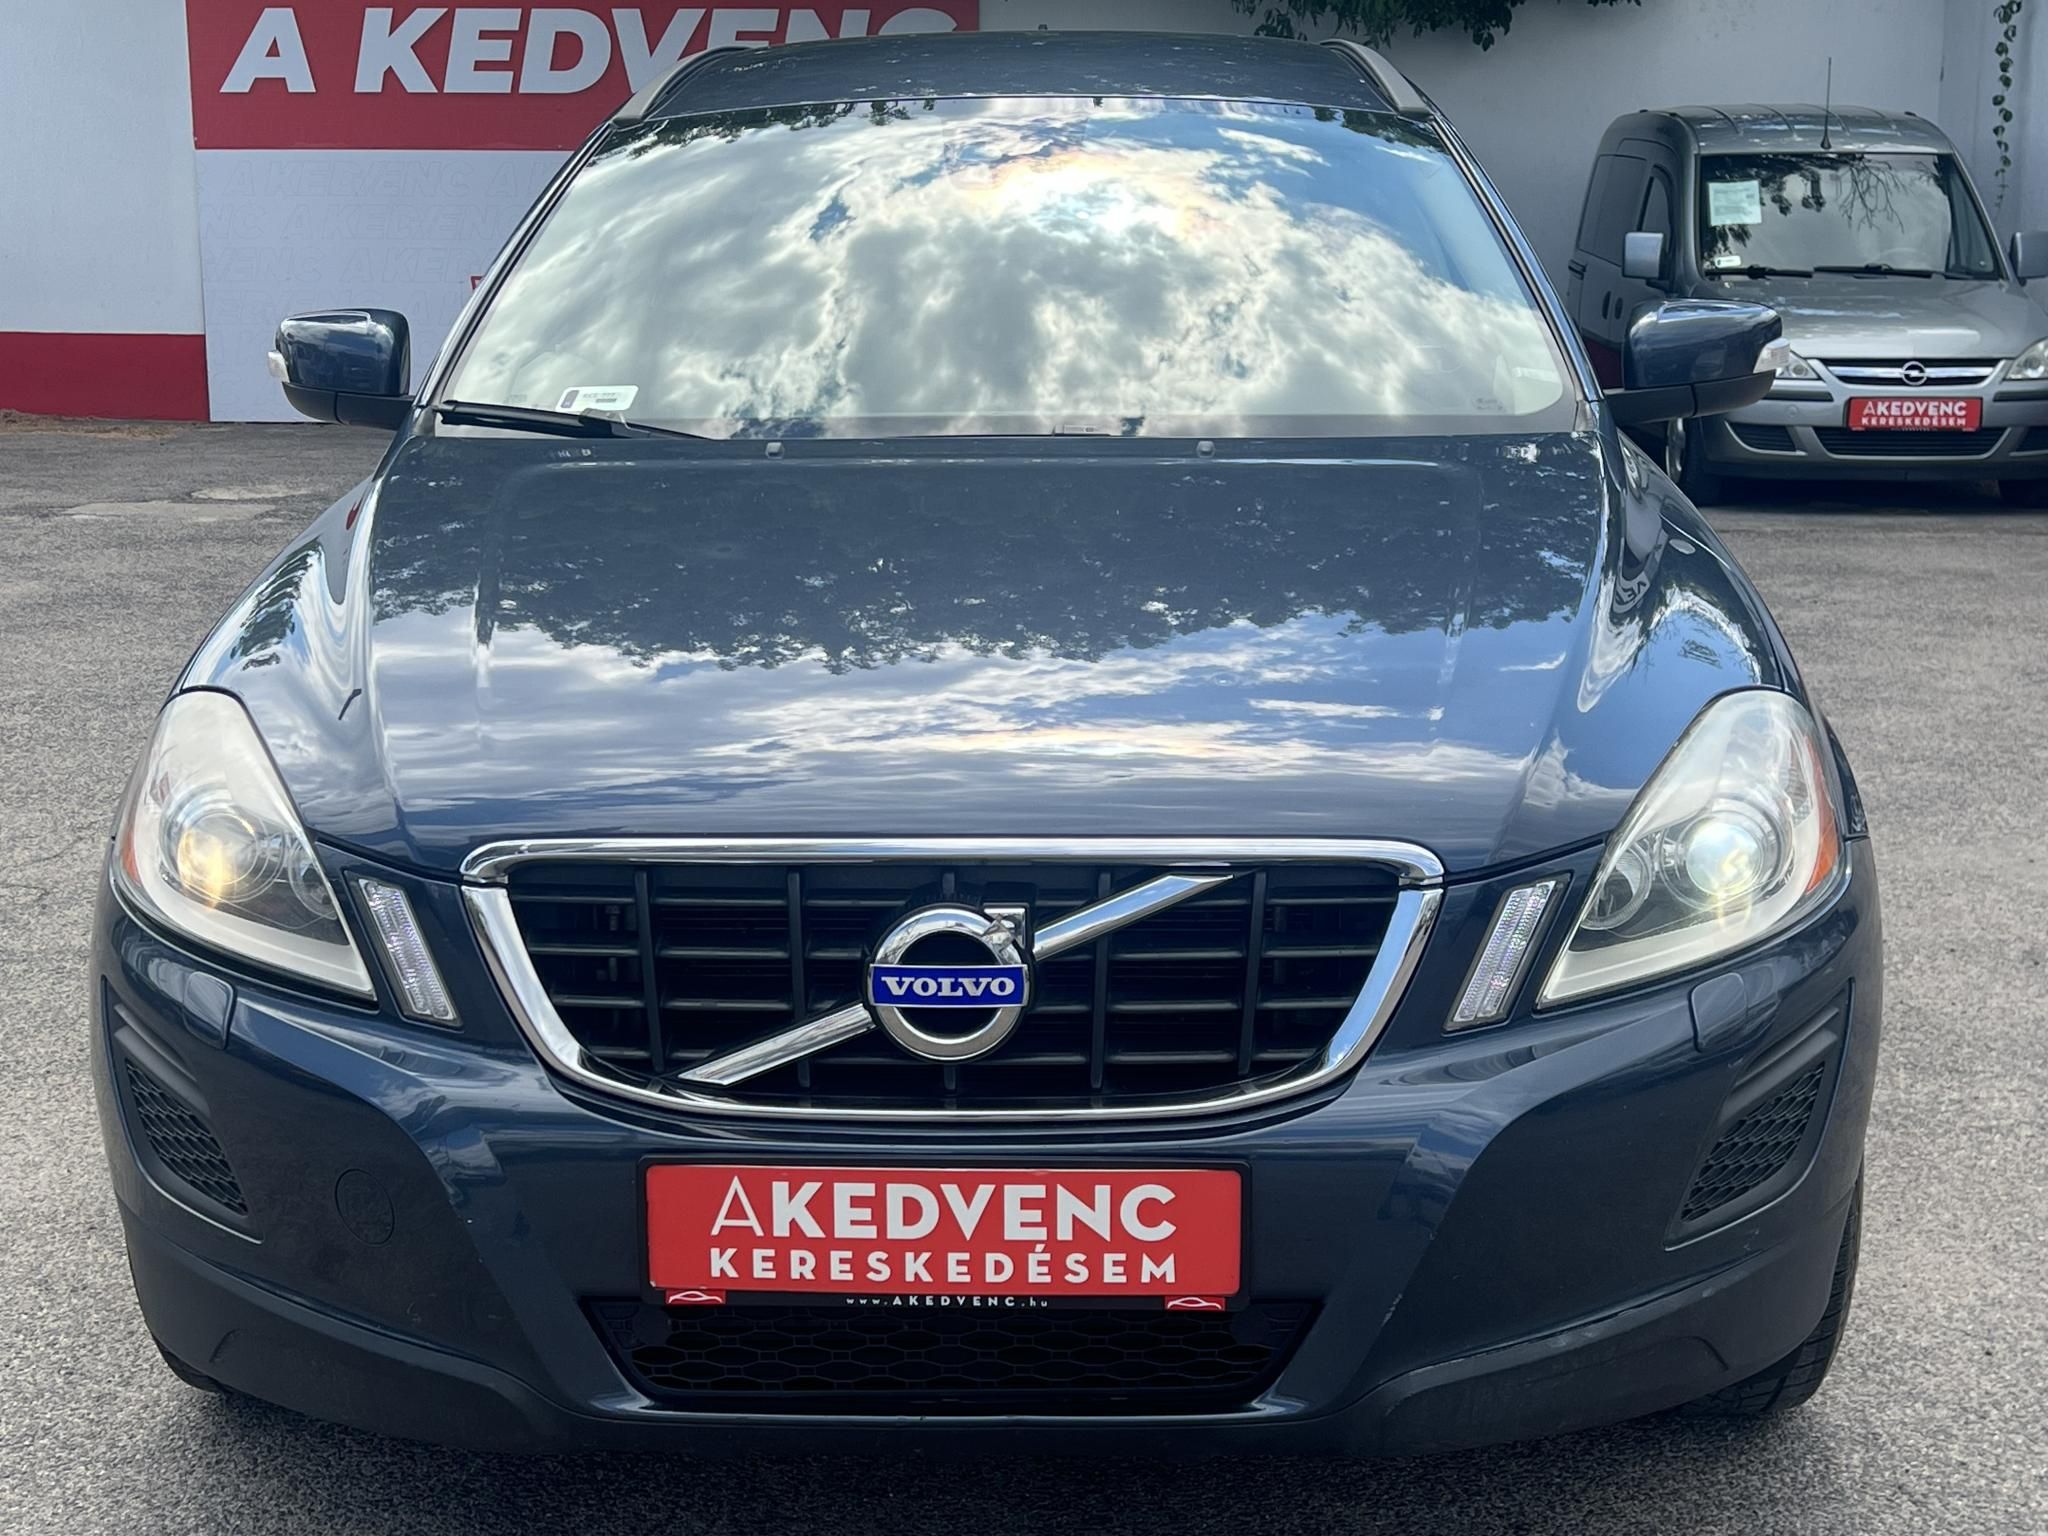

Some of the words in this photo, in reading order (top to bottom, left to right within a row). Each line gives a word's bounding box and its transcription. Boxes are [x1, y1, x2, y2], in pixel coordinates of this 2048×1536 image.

[219, 7, 317, 94] A
[353, 7, 958, 94] KEDV
[1861, 415, 1967, 427] KERESKEDÉSEM
[881, 976, 1016, 998] VOLVO
[710, 1175, 1177, 1242] AKEDVENC
[709, 1243, 1177, 1284] KERESKEDÉSEM
[846, 1295, 1048, 1307] www.AKEDVENC.hu
